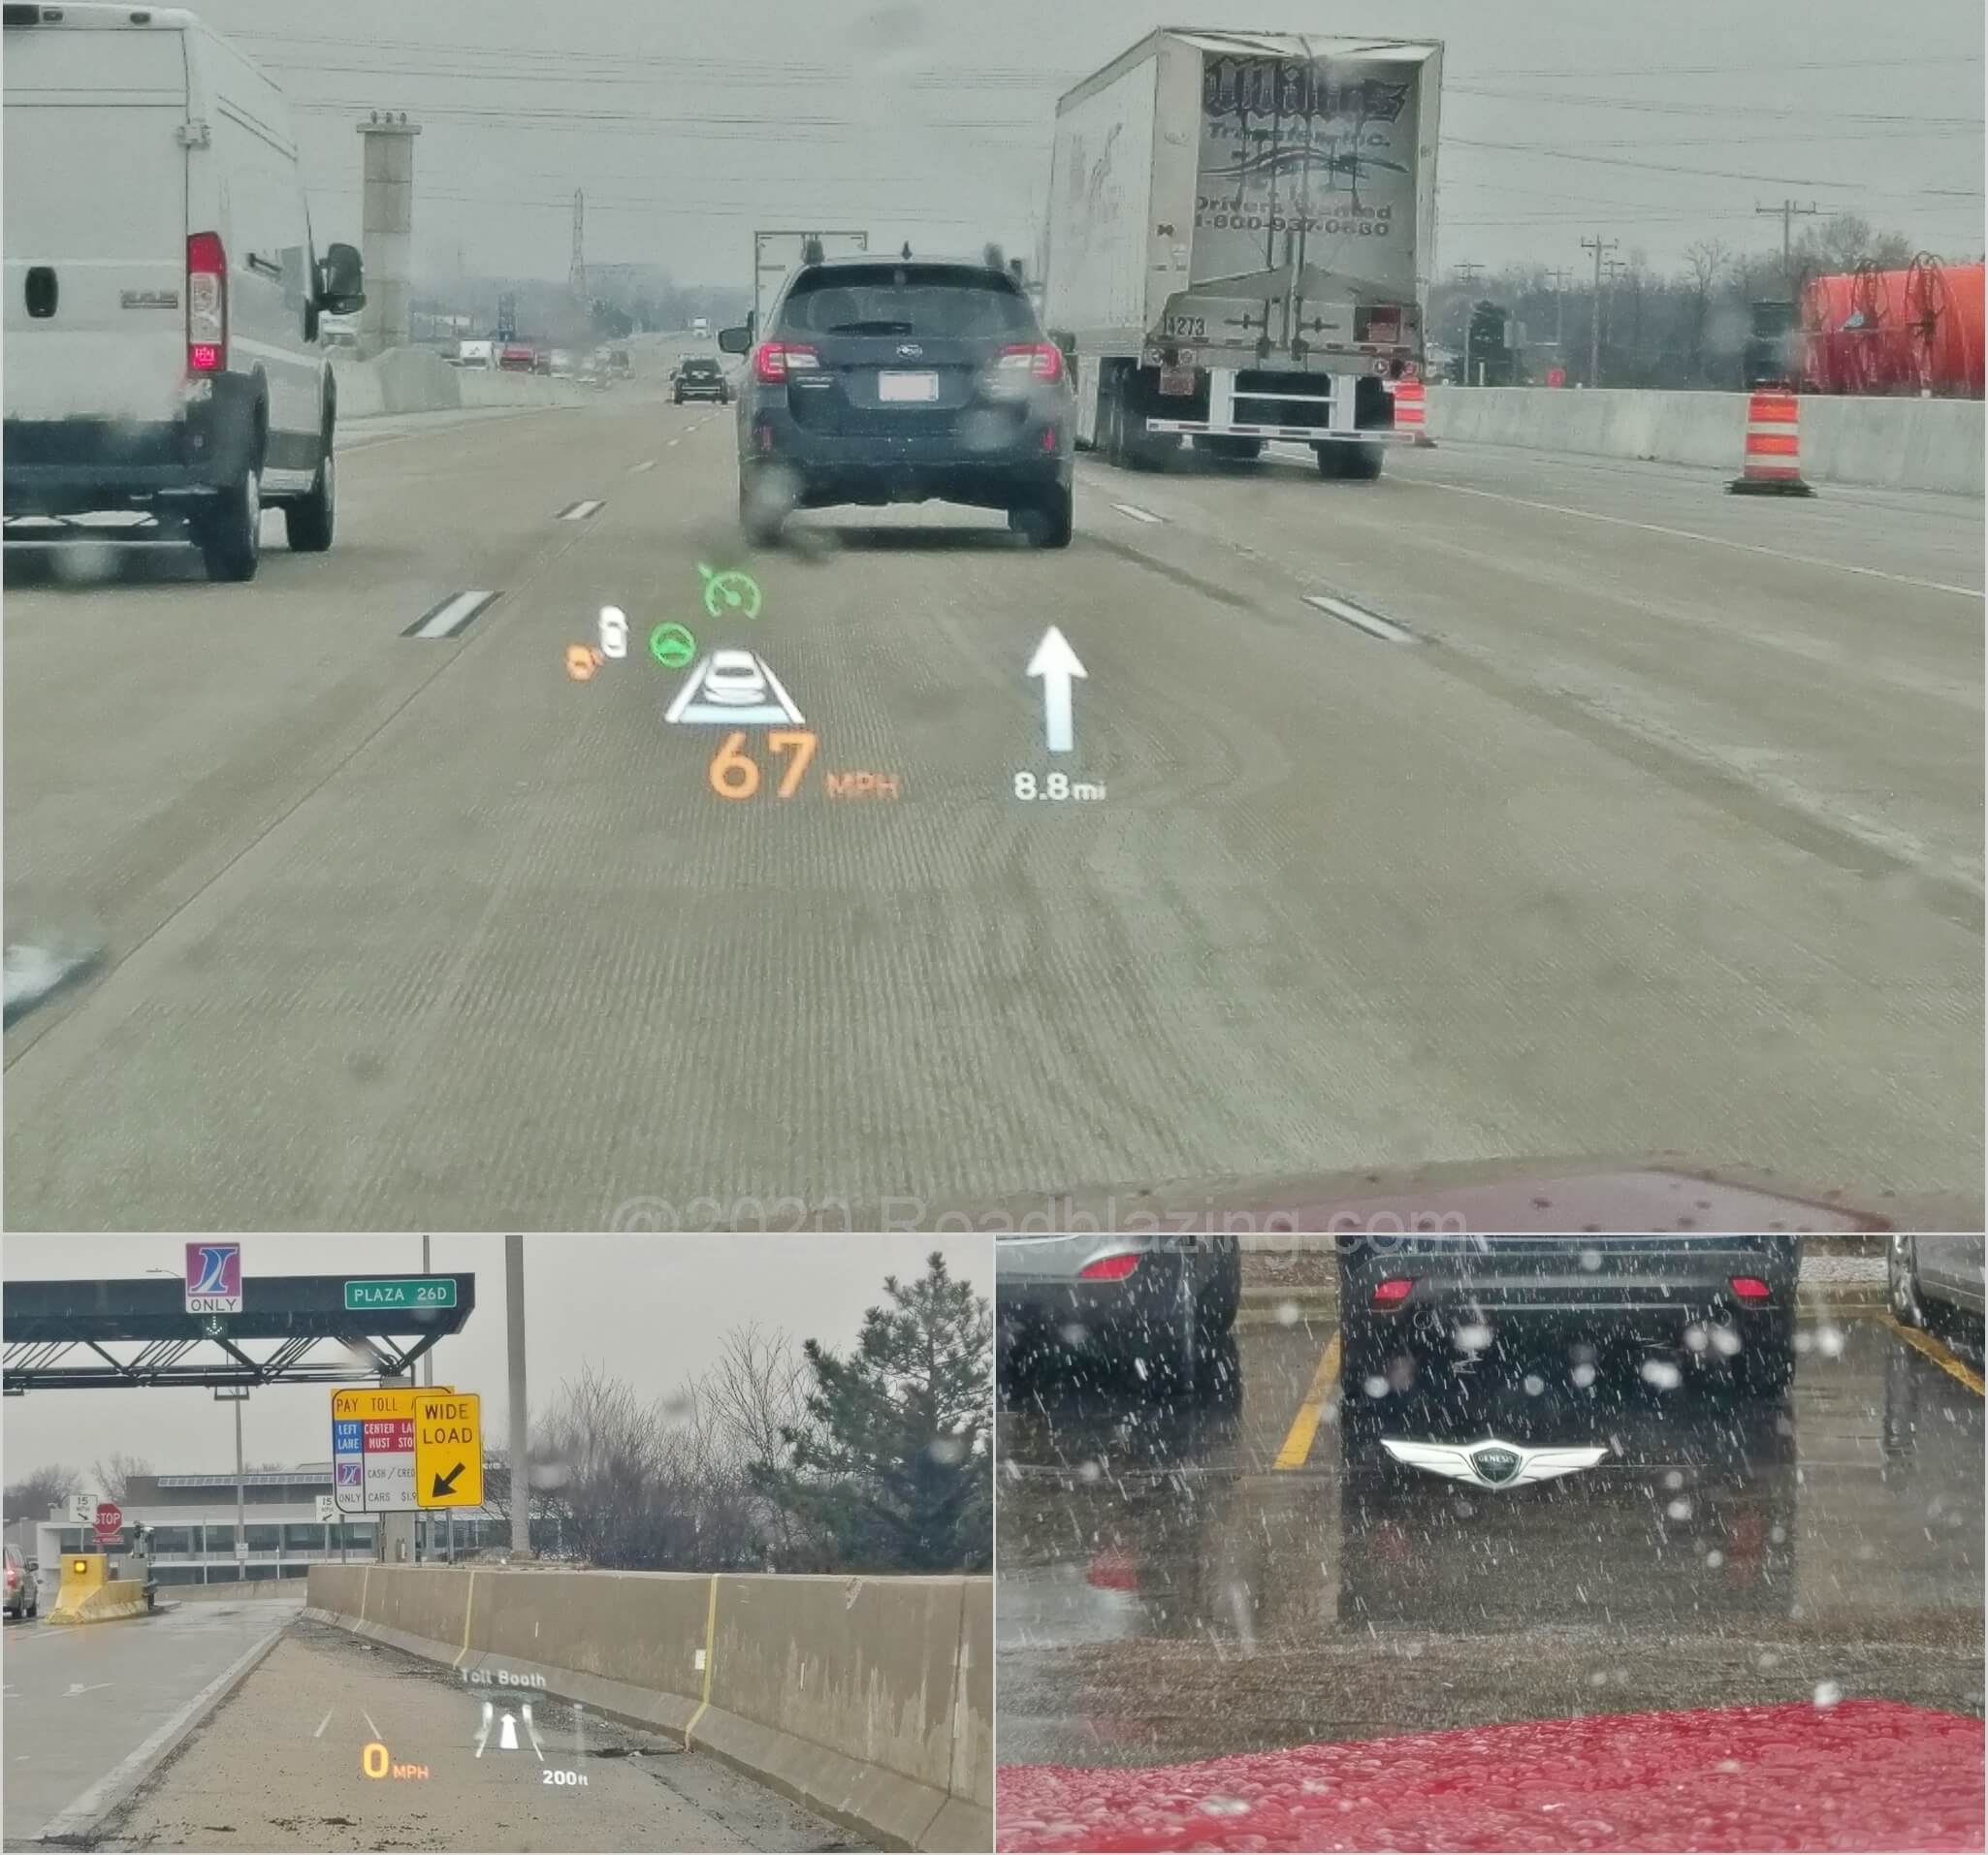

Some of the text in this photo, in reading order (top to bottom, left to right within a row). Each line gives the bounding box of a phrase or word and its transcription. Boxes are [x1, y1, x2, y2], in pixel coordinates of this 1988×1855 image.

[709, 730, 900, 800] 67 MPH
[354, 1287, 447, 1302] PLAZA 26D
[191, 1298, 237, 1312] ONLY
[336, 1397, 359, 1413] PAY
[371, 1396, 399, 1412] TOLL
[425, 1403, 468, 1421] WIDE
[338, 1423, 357, 1435] LEFT
[364, 1423, 395, 1435] CENTER
[423, 1427, 473, 1445] LOAD
[337, 1438, 360, 1451] LANE
[369, 1437, 414, 1449] MUST STO
[1478, 1455, 1515, 1464] GENESIS
[78, 1496, 89, 1506] 15
[322, 1496, 333, 1506] 15
[338, 1493, 361, 1503] ONLY
[368, 1491, 416, 1502] CARS $1.9
[95, 1512, 121, 1525] STOP
[462, 1669, 546, 1686] Toll Booth
[363, 1743, 430, 1780] 0 MPH
